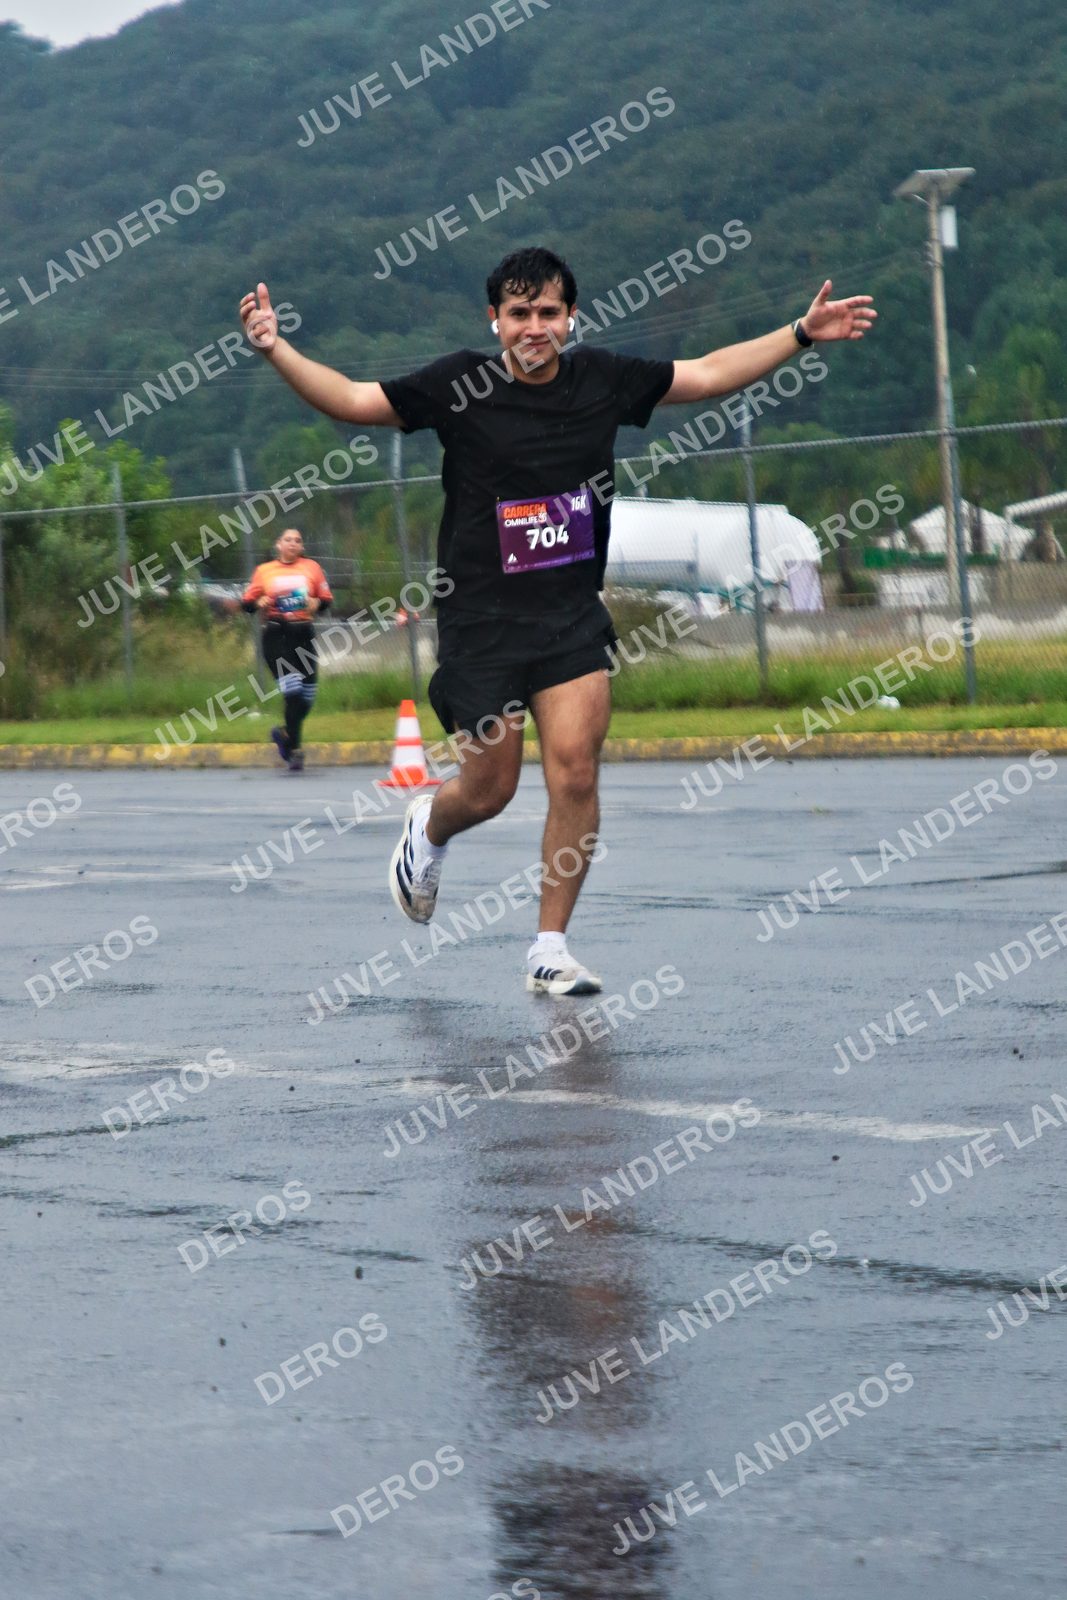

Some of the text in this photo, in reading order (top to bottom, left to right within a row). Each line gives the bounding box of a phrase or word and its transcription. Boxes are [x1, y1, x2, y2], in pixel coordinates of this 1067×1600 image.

[503, 502, 547, 519] CARRERA
[571, 495, 587, 511] 16K
[504, 516, 538, 527] OMNILIFE
[526, 524, 569, 550] 704
